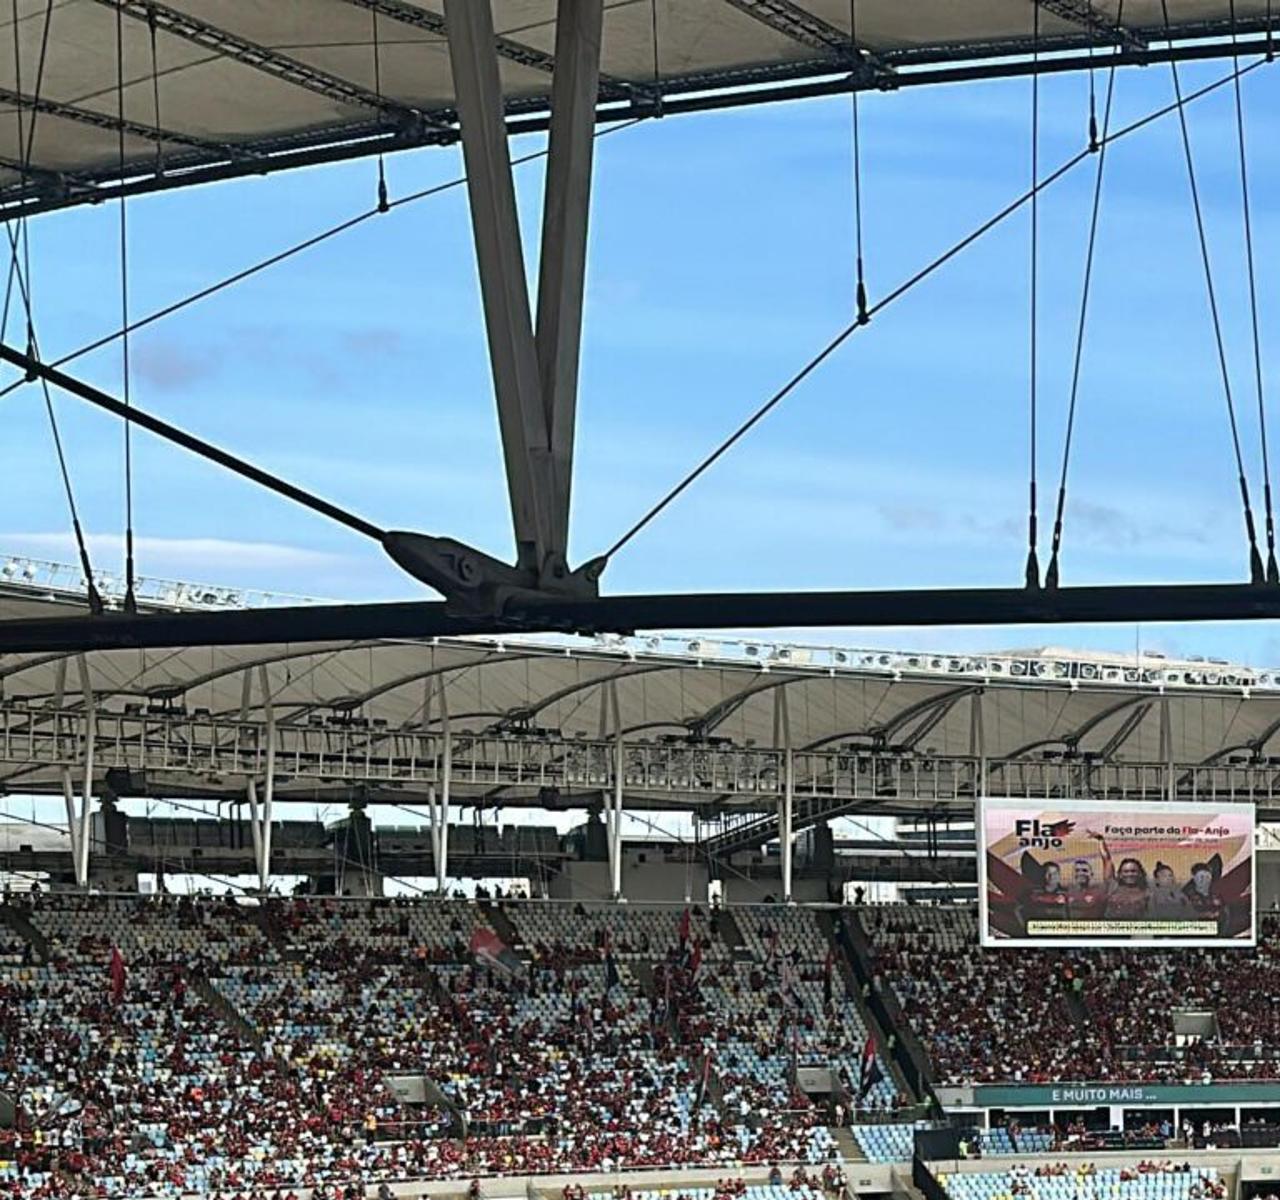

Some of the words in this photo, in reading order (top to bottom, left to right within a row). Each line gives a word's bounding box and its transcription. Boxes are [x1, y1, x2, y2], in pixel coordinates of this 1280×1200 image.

[1015, 819, 1054, 837] Fla
[1019, 837, 1063, 850] anjo
[1052, 1090, 1060, 1101] E
[1063, 1089, 1106, 1101] MUITO
[1109, 1088, 1144, 1100] MAIS
